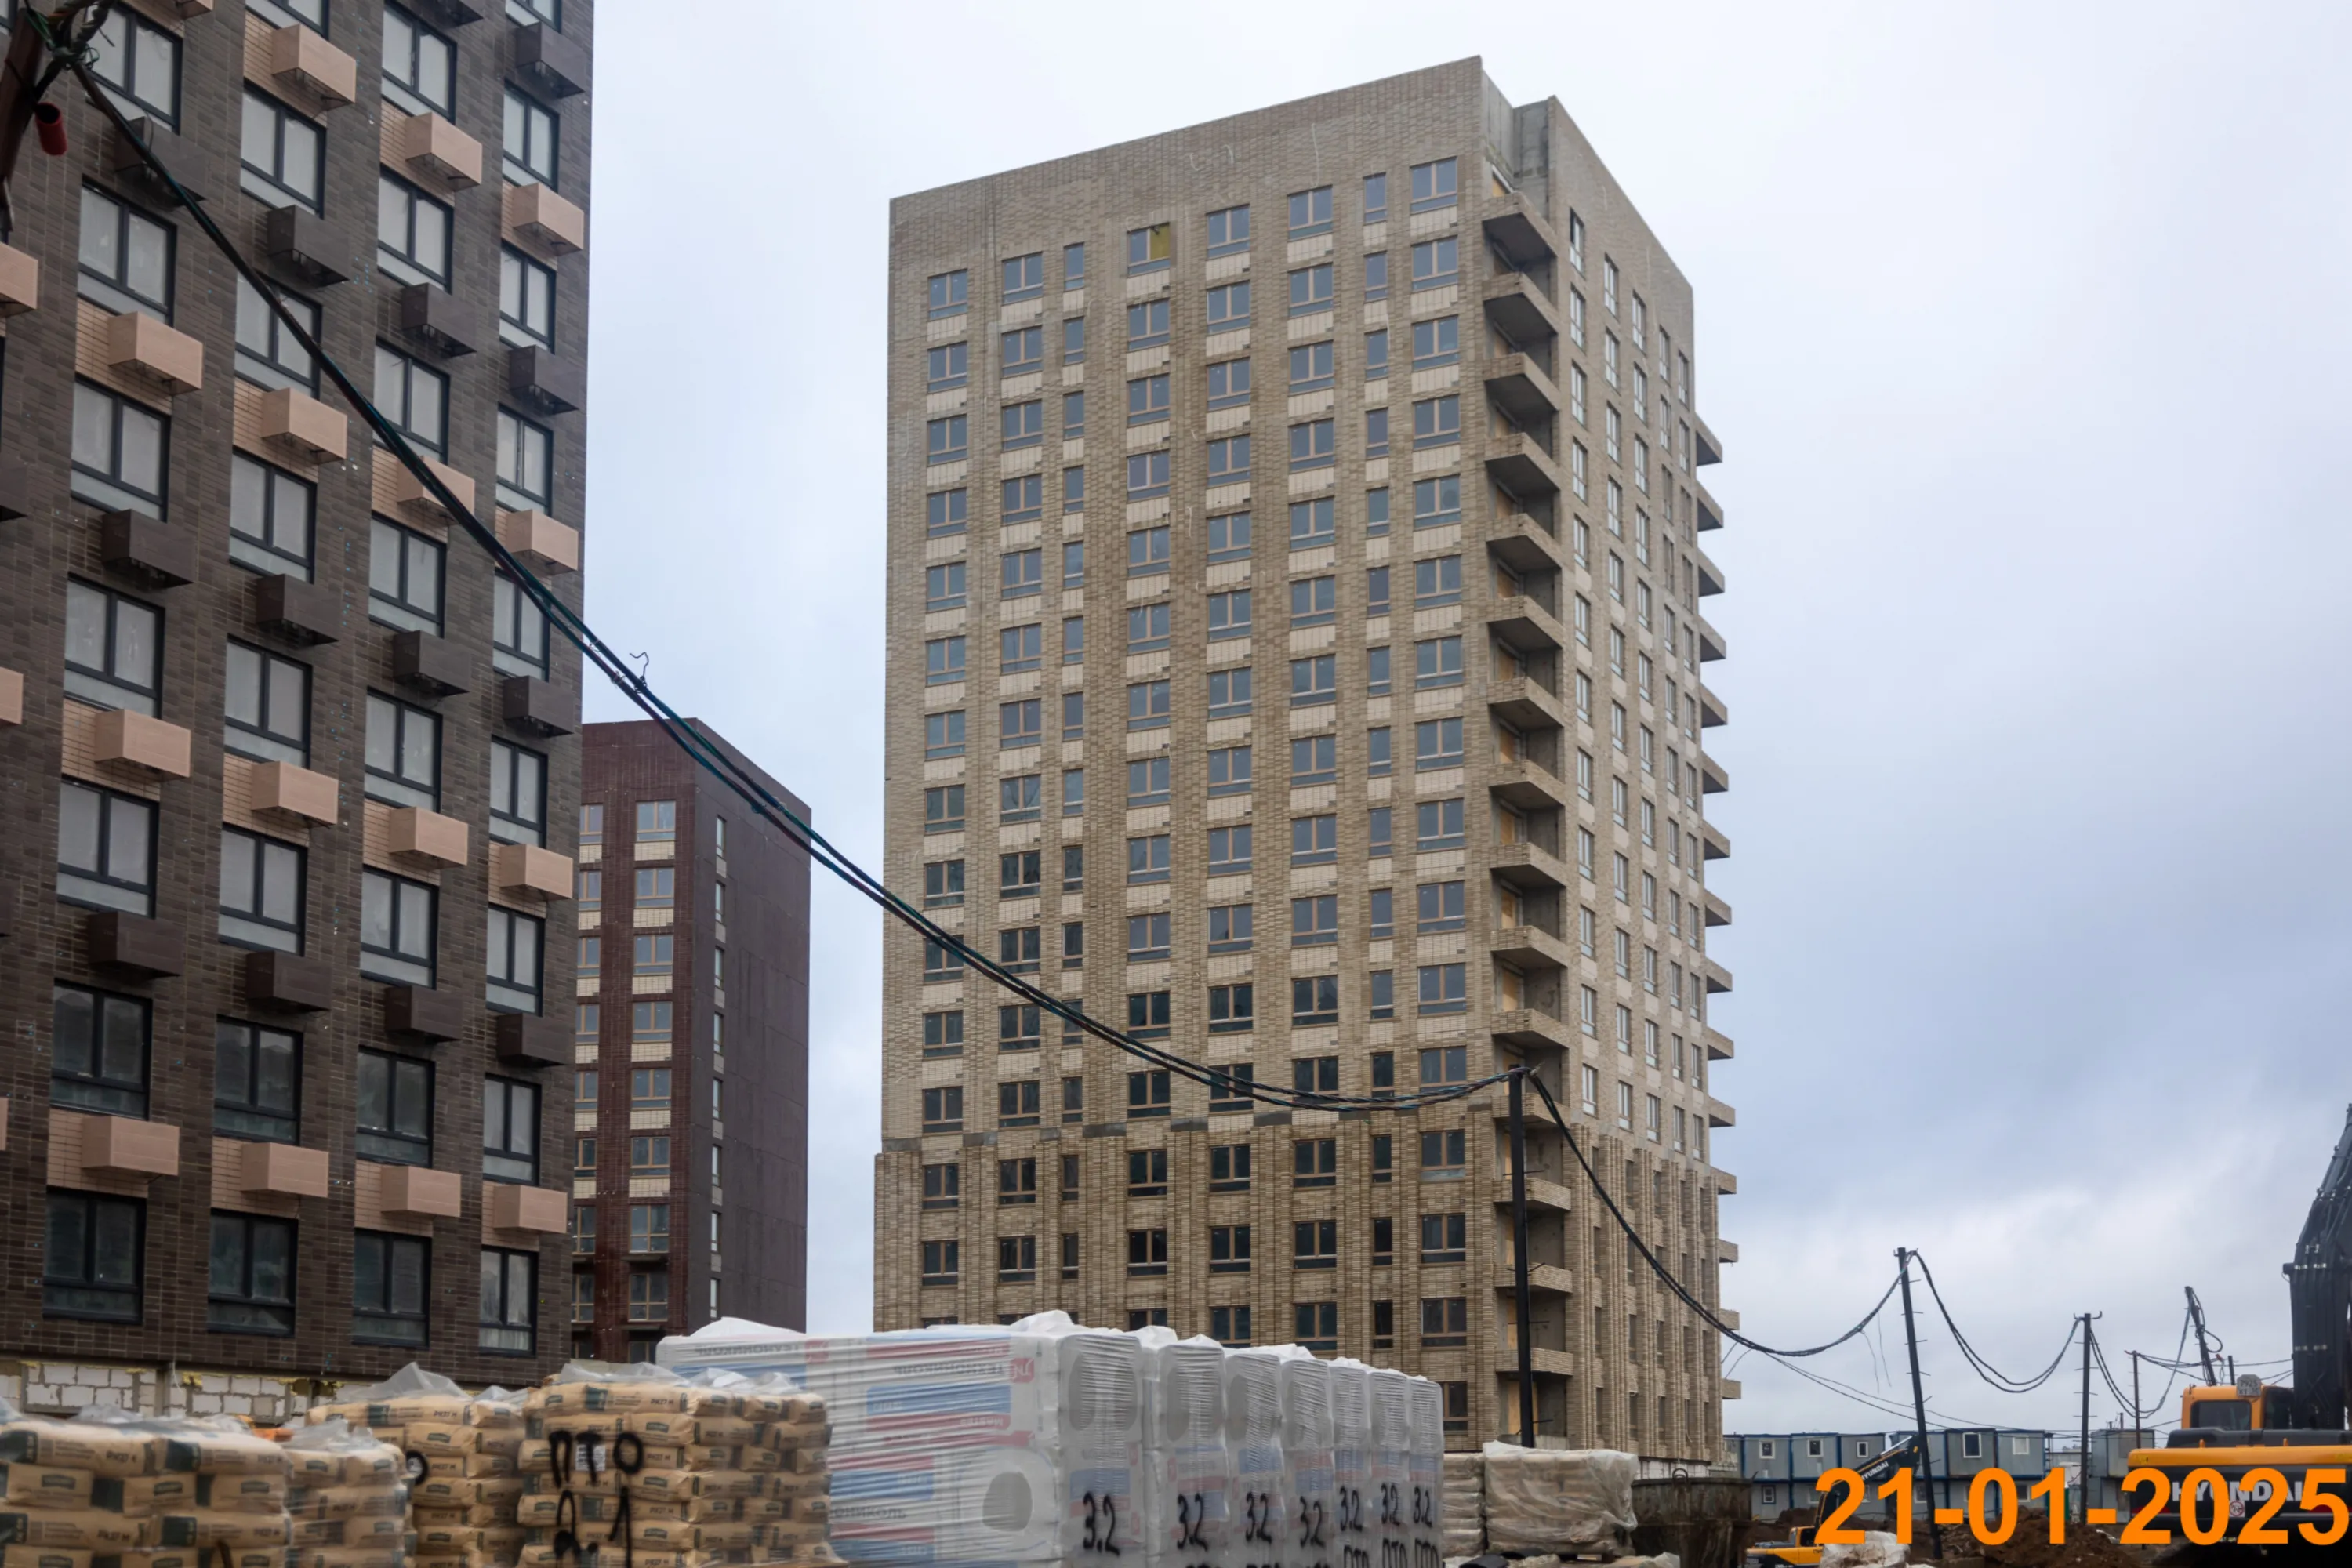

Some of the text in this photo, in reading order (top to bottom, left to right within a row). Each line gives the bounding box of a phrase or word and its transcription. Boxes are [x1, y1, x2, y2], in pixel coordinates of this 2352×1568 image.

[549, 1430, 644, 1488] ПТО
[1083, 1490, 1120, 1557] 3.2
[1177, 1492, 1209, 1552] 3.2
[1245, 1491, 1272, 1544] 3.2
[1339, 1486, 1363, 1532] 3.2
[1381, 1482, 1400, 1527] 3.2
